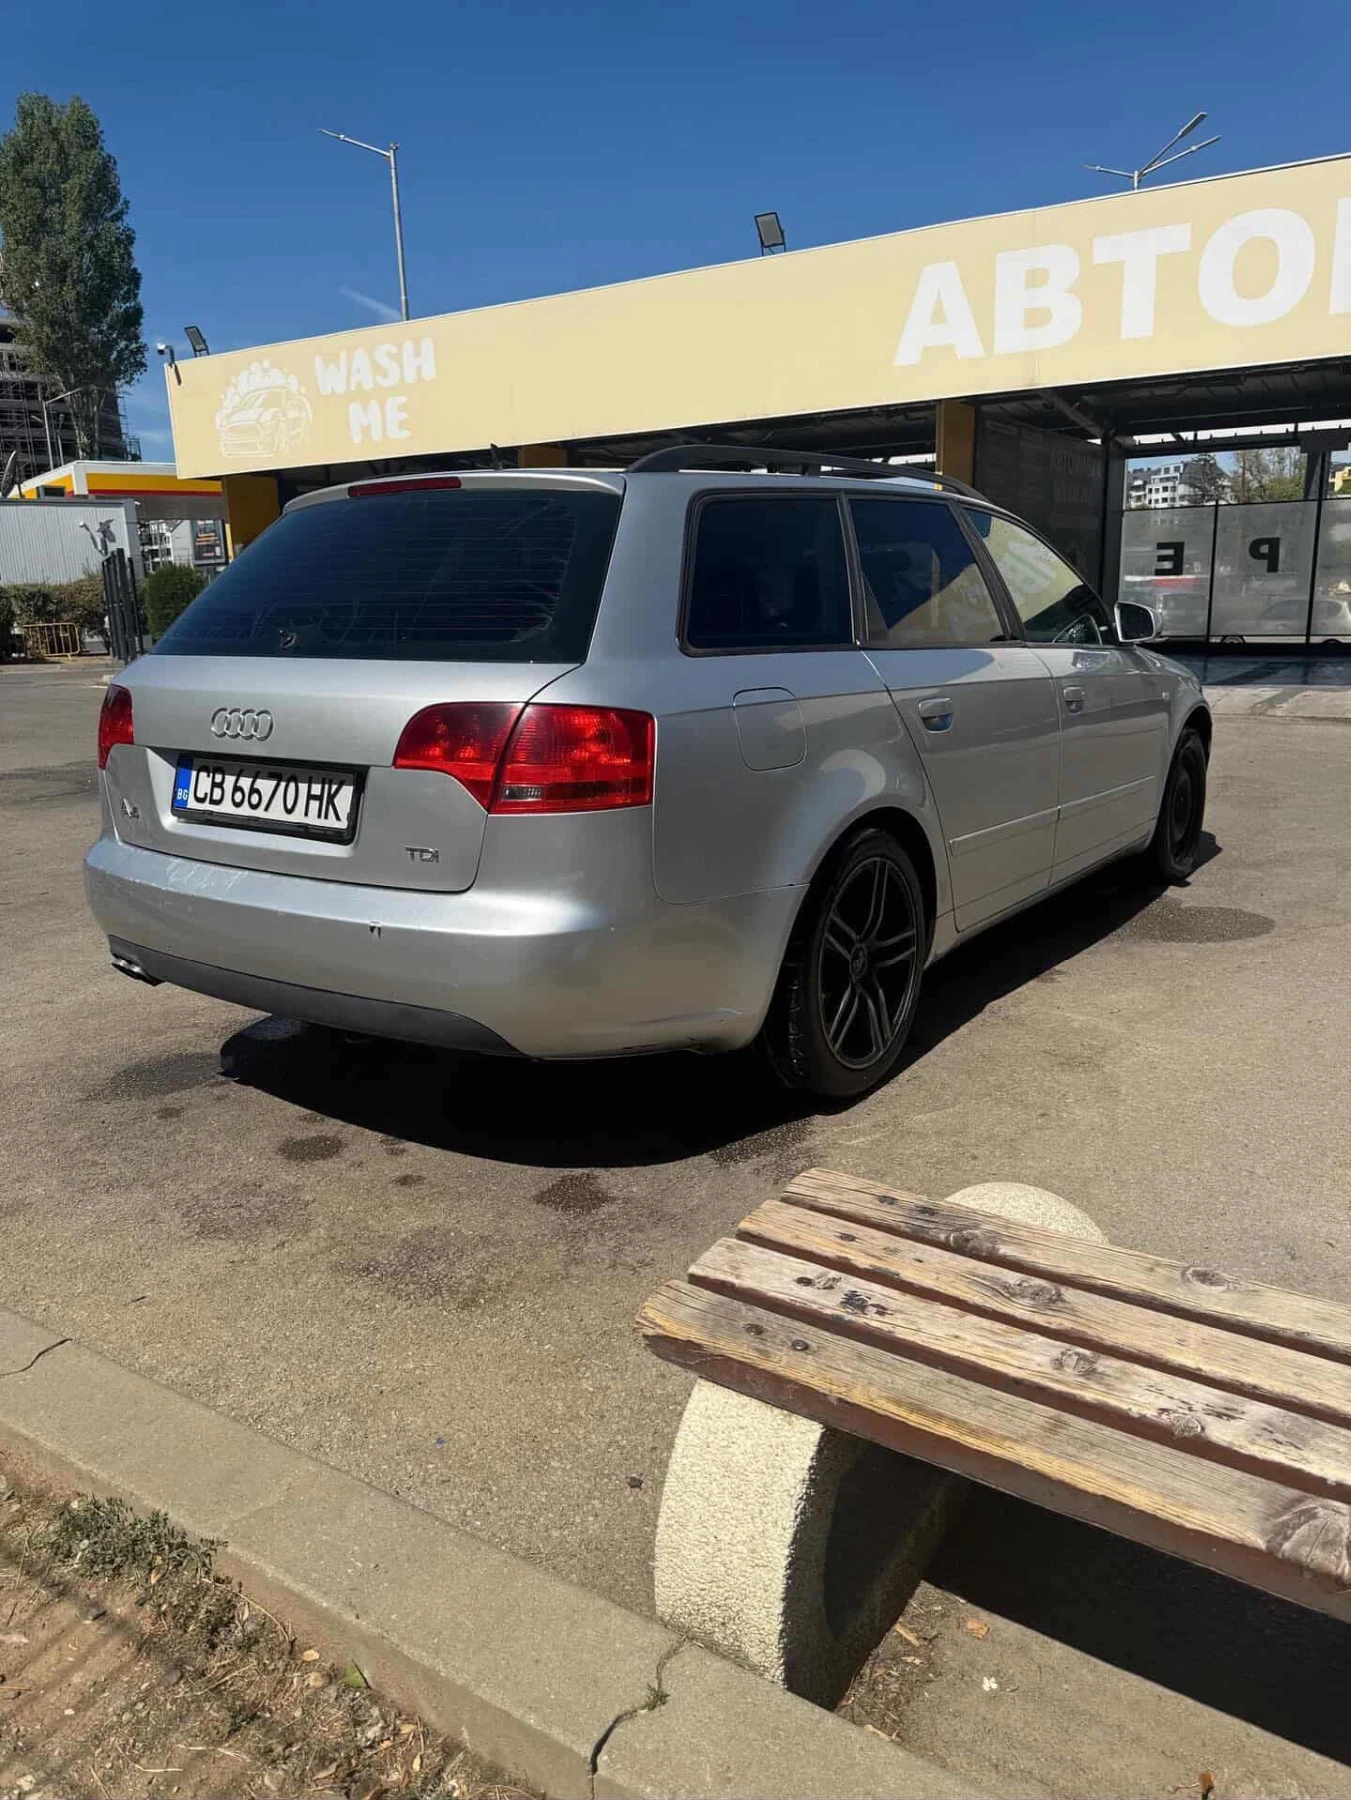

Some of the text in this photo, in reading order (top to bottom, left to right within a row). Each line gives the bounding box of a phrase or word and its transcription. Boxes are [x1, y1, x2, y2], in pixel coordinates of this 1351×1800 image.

[893, 197, 1351, 366] АВТО
[315, 337, 437, 396] WASH
[348, 396, 412, 444] ME
[177, 788, 189, 801] BG
[231, 768, 300, 815] 6670
[405, 845, 440, 864] TDI
